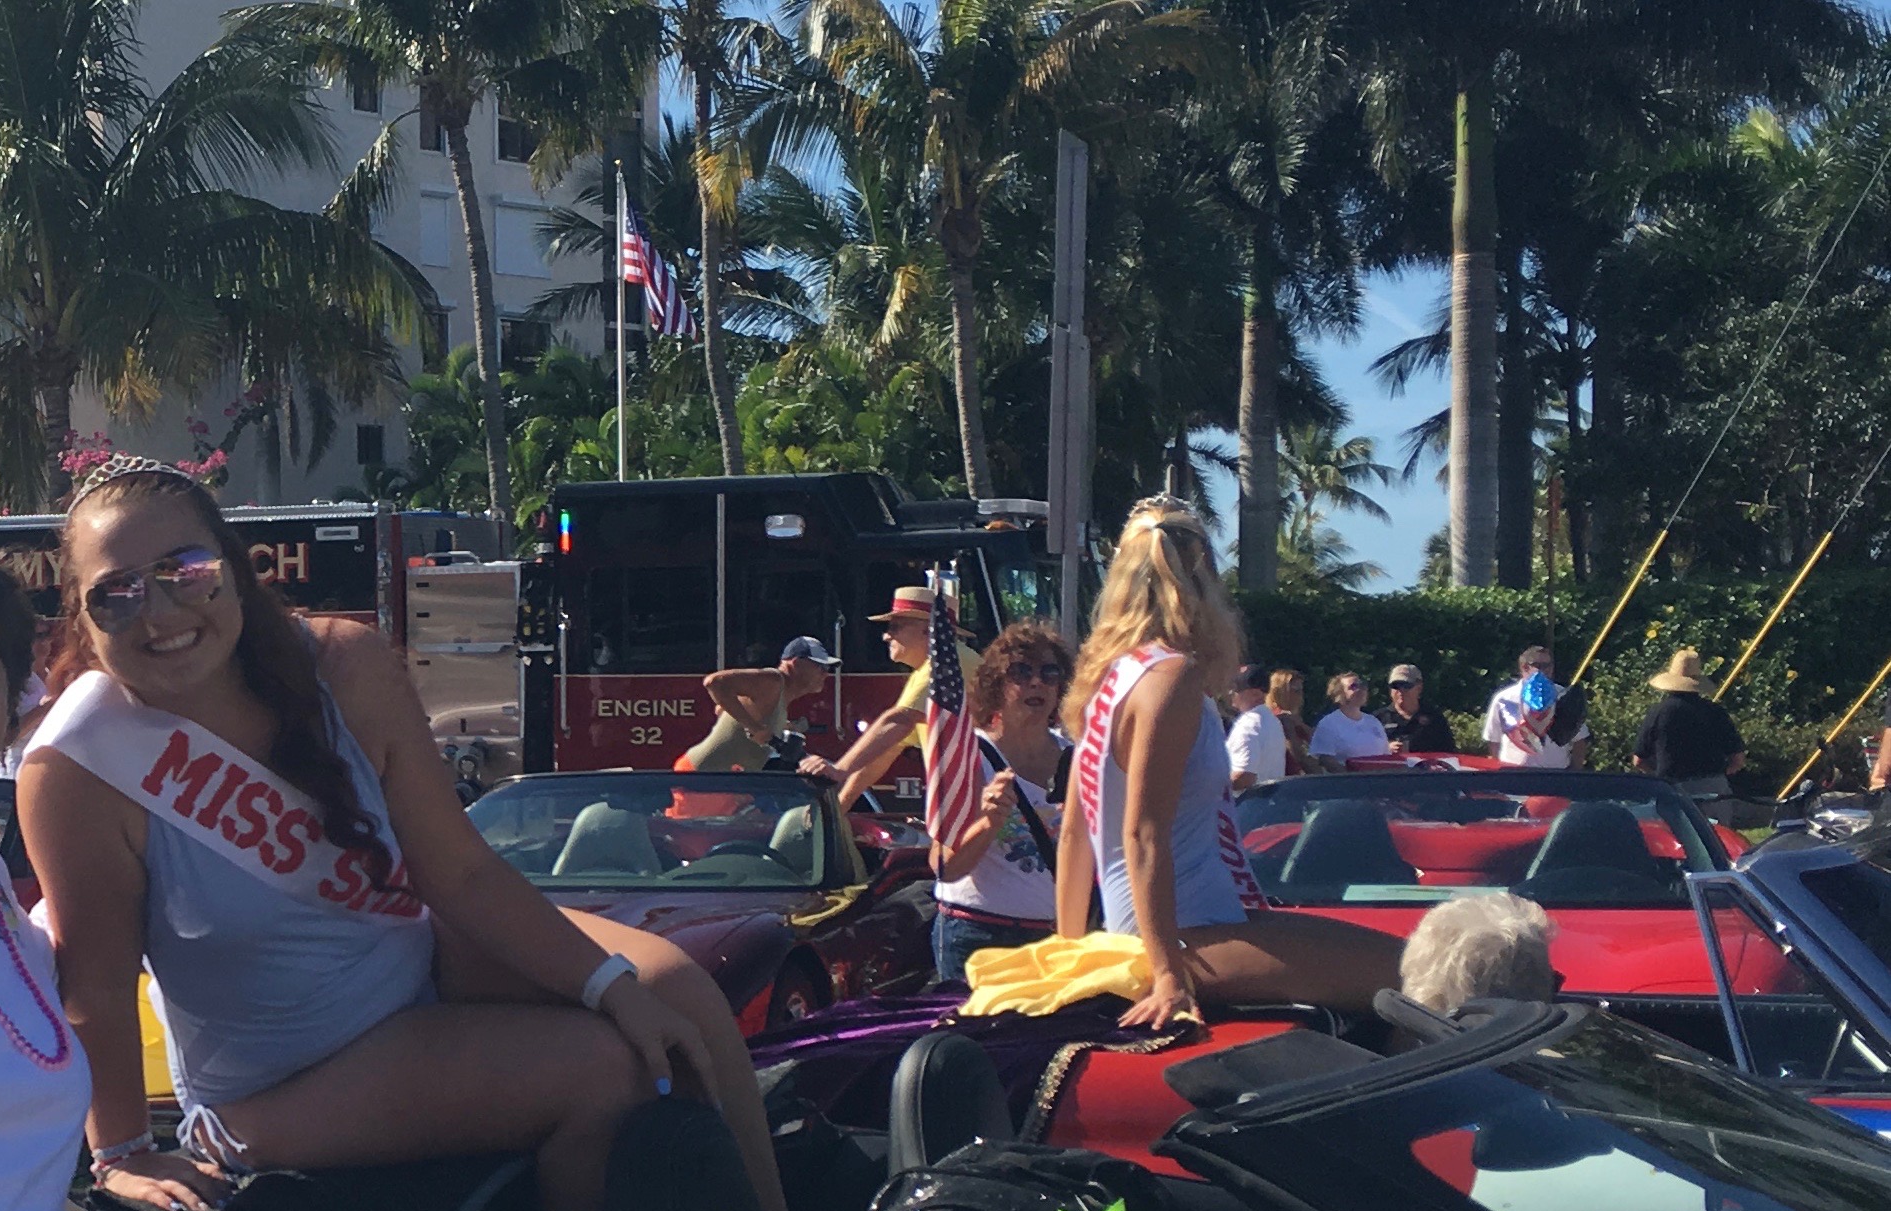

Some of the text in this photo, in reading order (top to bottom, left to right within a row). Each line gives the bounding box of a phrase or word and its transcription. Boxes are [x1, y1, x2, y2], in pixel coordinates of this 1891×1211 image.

[597, 699, 696, 717] ENGINE
[629, 726, 664, 745] 32
[1079, 669, 1119, 836] SHRIMP
[140, 729, 322, 874] MISS
